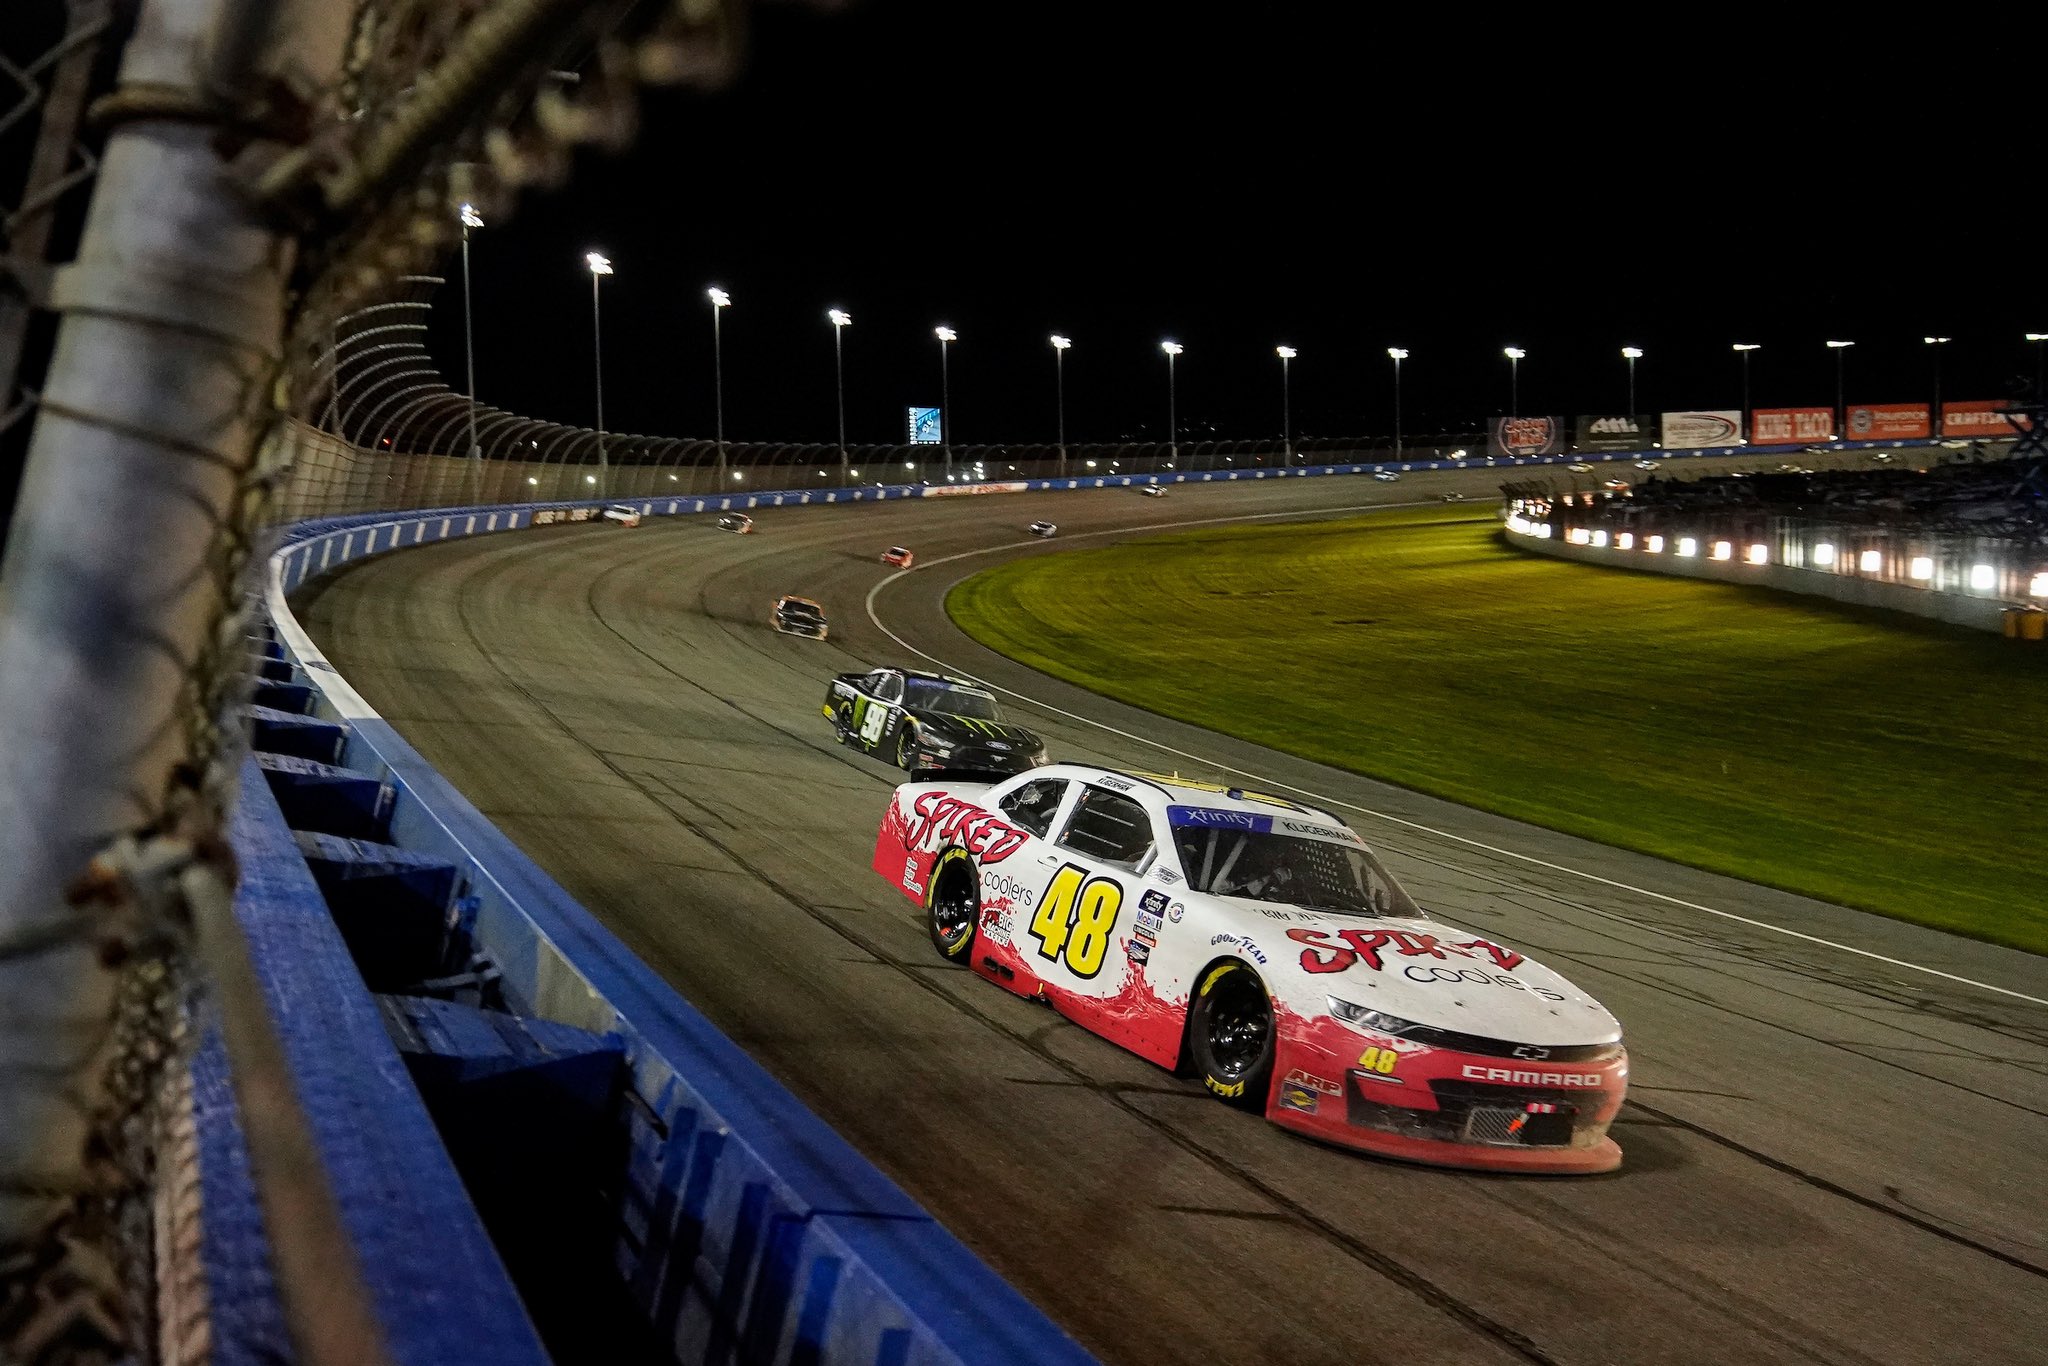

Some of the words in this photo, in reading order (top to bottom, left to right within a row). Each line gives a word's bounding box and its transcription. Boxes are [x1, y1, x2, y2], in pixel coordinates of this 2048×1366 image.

[905, 791, 1030, 867] SPIKED
[1186, 808, 1254, 829] xfinity
[984, 871, 1033, 906] coolers
[999, 911, 1013, 931] BIG
[1028, 861, 1125, 980] 48
[1404, 965, 1566, 1001] cooles
[1358, 1046, 1399, 1075] 48
[1461, 1064, 1602, 1086] CAMARO
